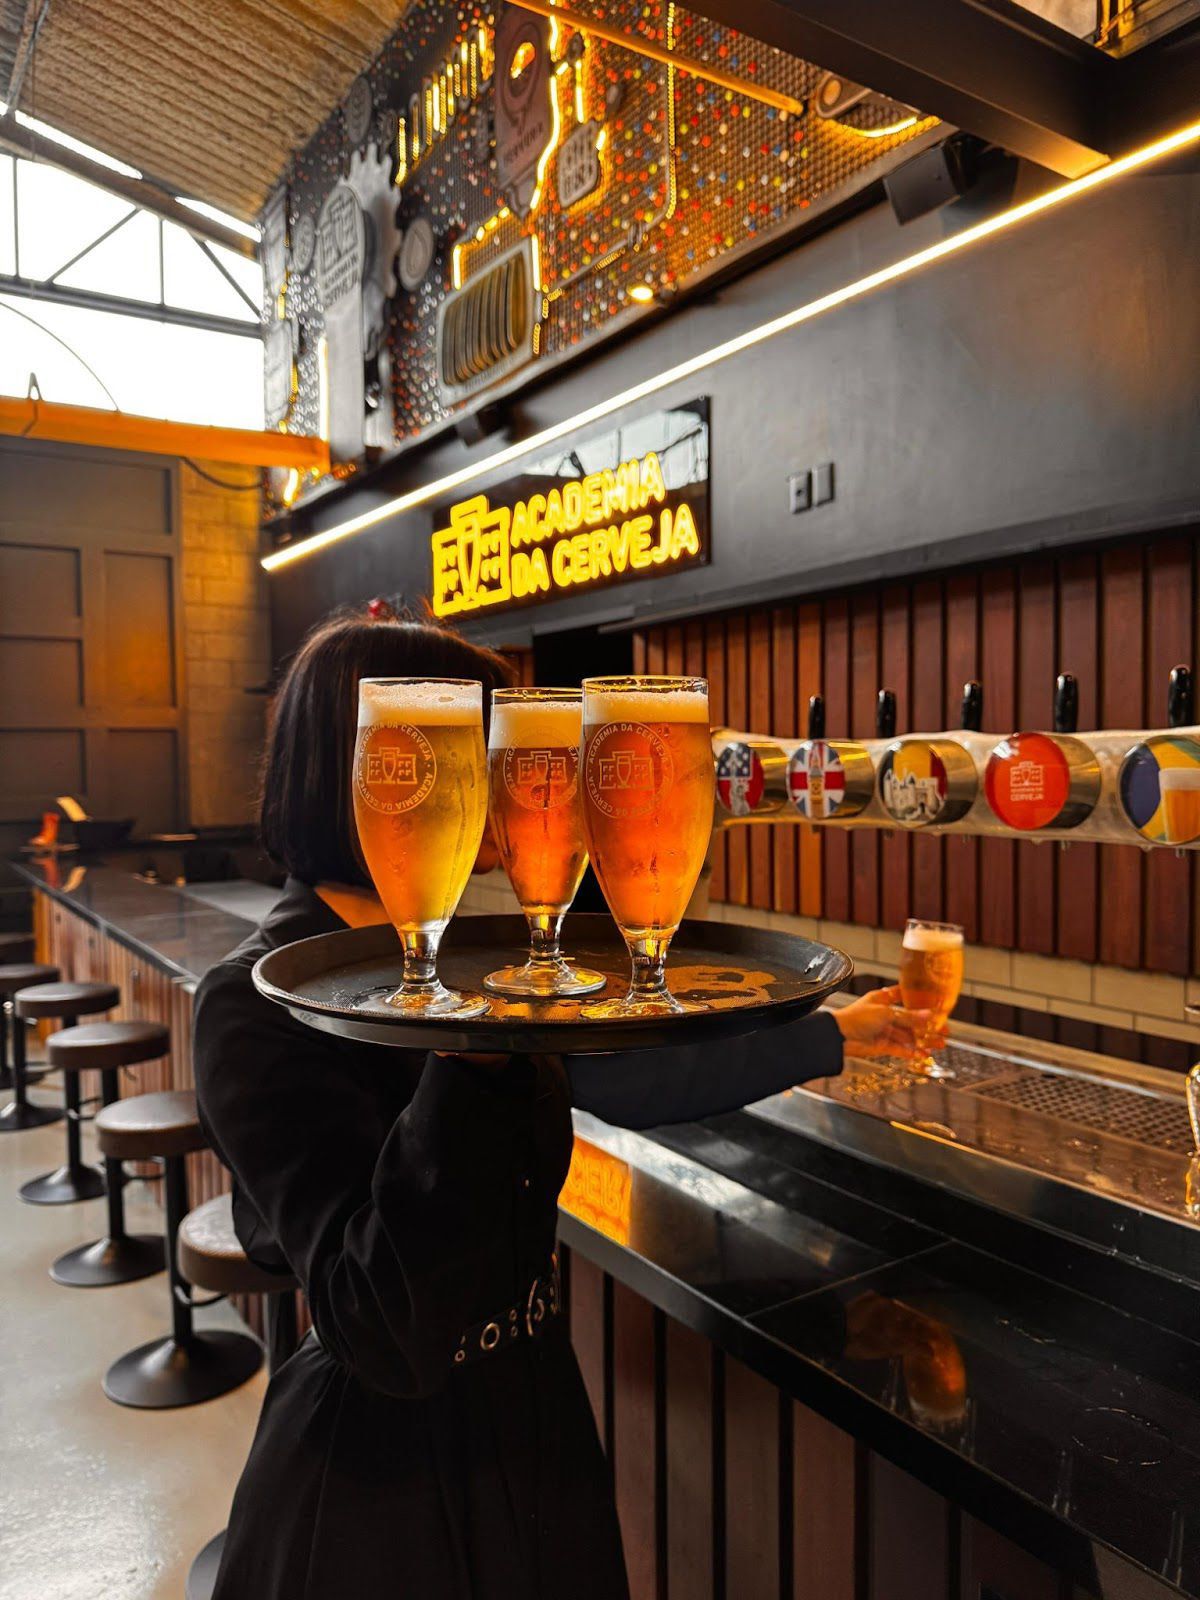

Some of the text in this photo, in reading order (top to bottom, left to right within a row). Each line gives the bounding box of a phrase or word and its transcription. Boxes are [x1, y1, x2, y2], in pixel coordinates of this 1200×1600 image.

[510, 452, 665, 548] ACADEMIA
[511, 503, 699, 597] DA CERVEJA
[401, 724, 432, 761] CERVEJA
[589, 725, 618, 764] ACADEMIA
[621, 723, 633, 732] DA
[636, 726, 668, 761] CERVEJA
[381, 802, 393, 811] DA
[395, 772, 433, 809] ACADEMIA
[588, 776, 613, 813] CERVEJA
